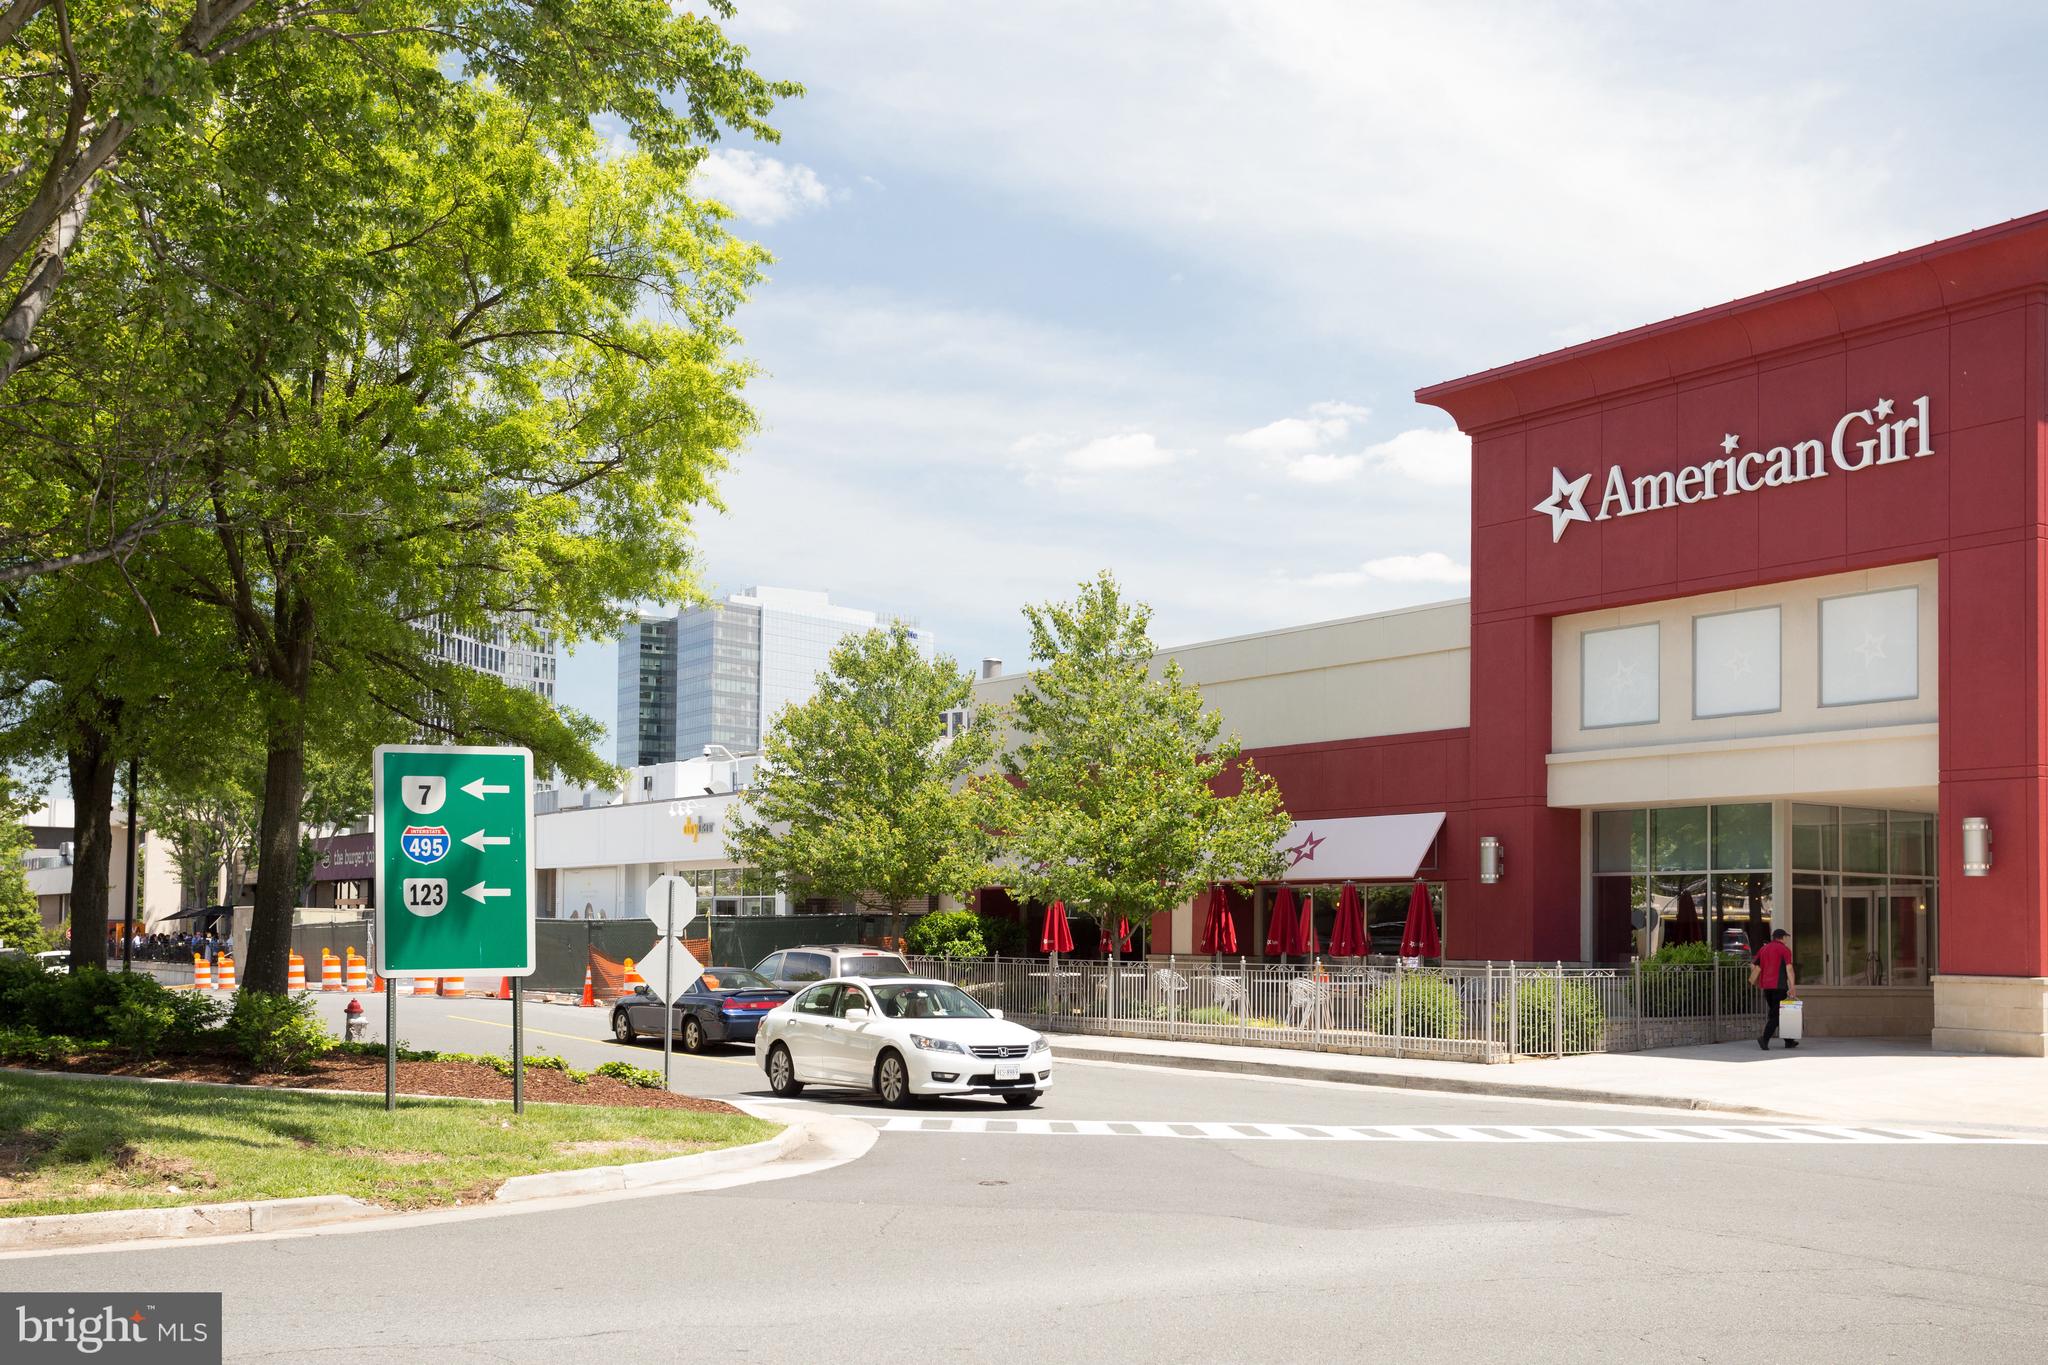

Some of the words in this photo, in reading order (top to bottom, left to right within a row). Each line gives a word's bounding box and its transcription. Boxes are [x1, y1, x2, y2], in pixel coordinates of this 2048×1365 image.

[1595, 432, 1829, 521] American
[1830, 395, 1935, 472] Girl
[418, 785, 432, 805] 7
[409, 838, 443, 857] 495
[333, 849, 344, 866] the
[344, 849, 365, 868] burger
[410, 884, 443, 906] 123
